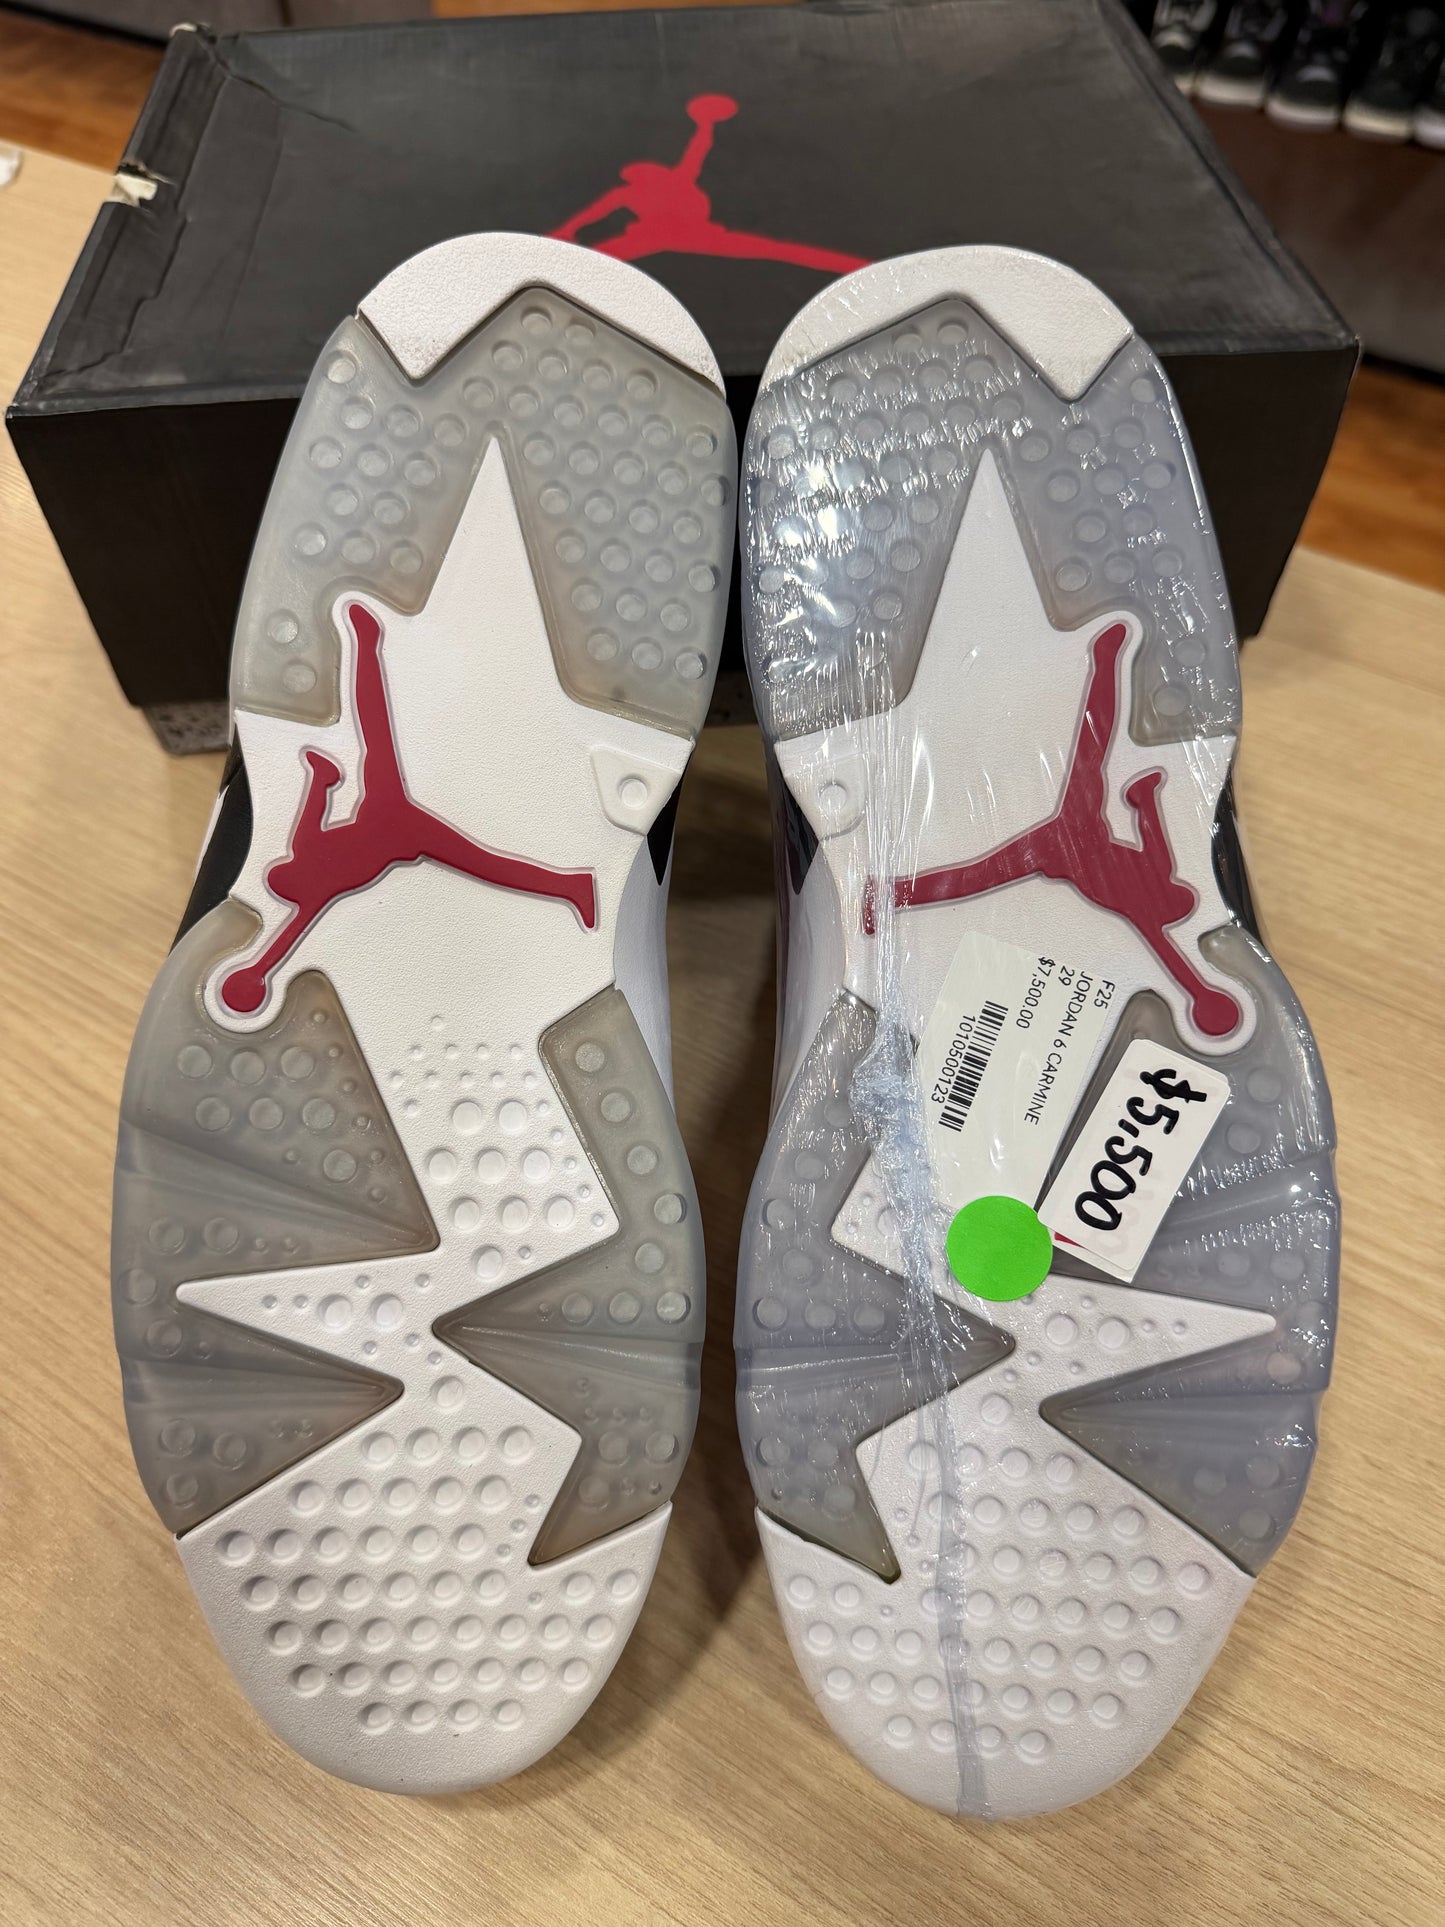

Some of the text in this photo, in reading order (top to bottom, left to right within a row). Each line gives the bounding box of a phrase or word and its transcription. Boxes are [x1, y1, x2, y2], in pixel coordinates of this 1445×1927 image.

[1016, 956, 1056, 1030] $7,500.00
[1059, 965, 1076, 987] 29
[1093, 979, 1116, 1010] F25
[931, 1015, 977, 1105] 1010500123
[1024, 970, 1094, 1126] JORDAN 6 CARMINE
[1074, 1068, 1208, 1231] $5,500
